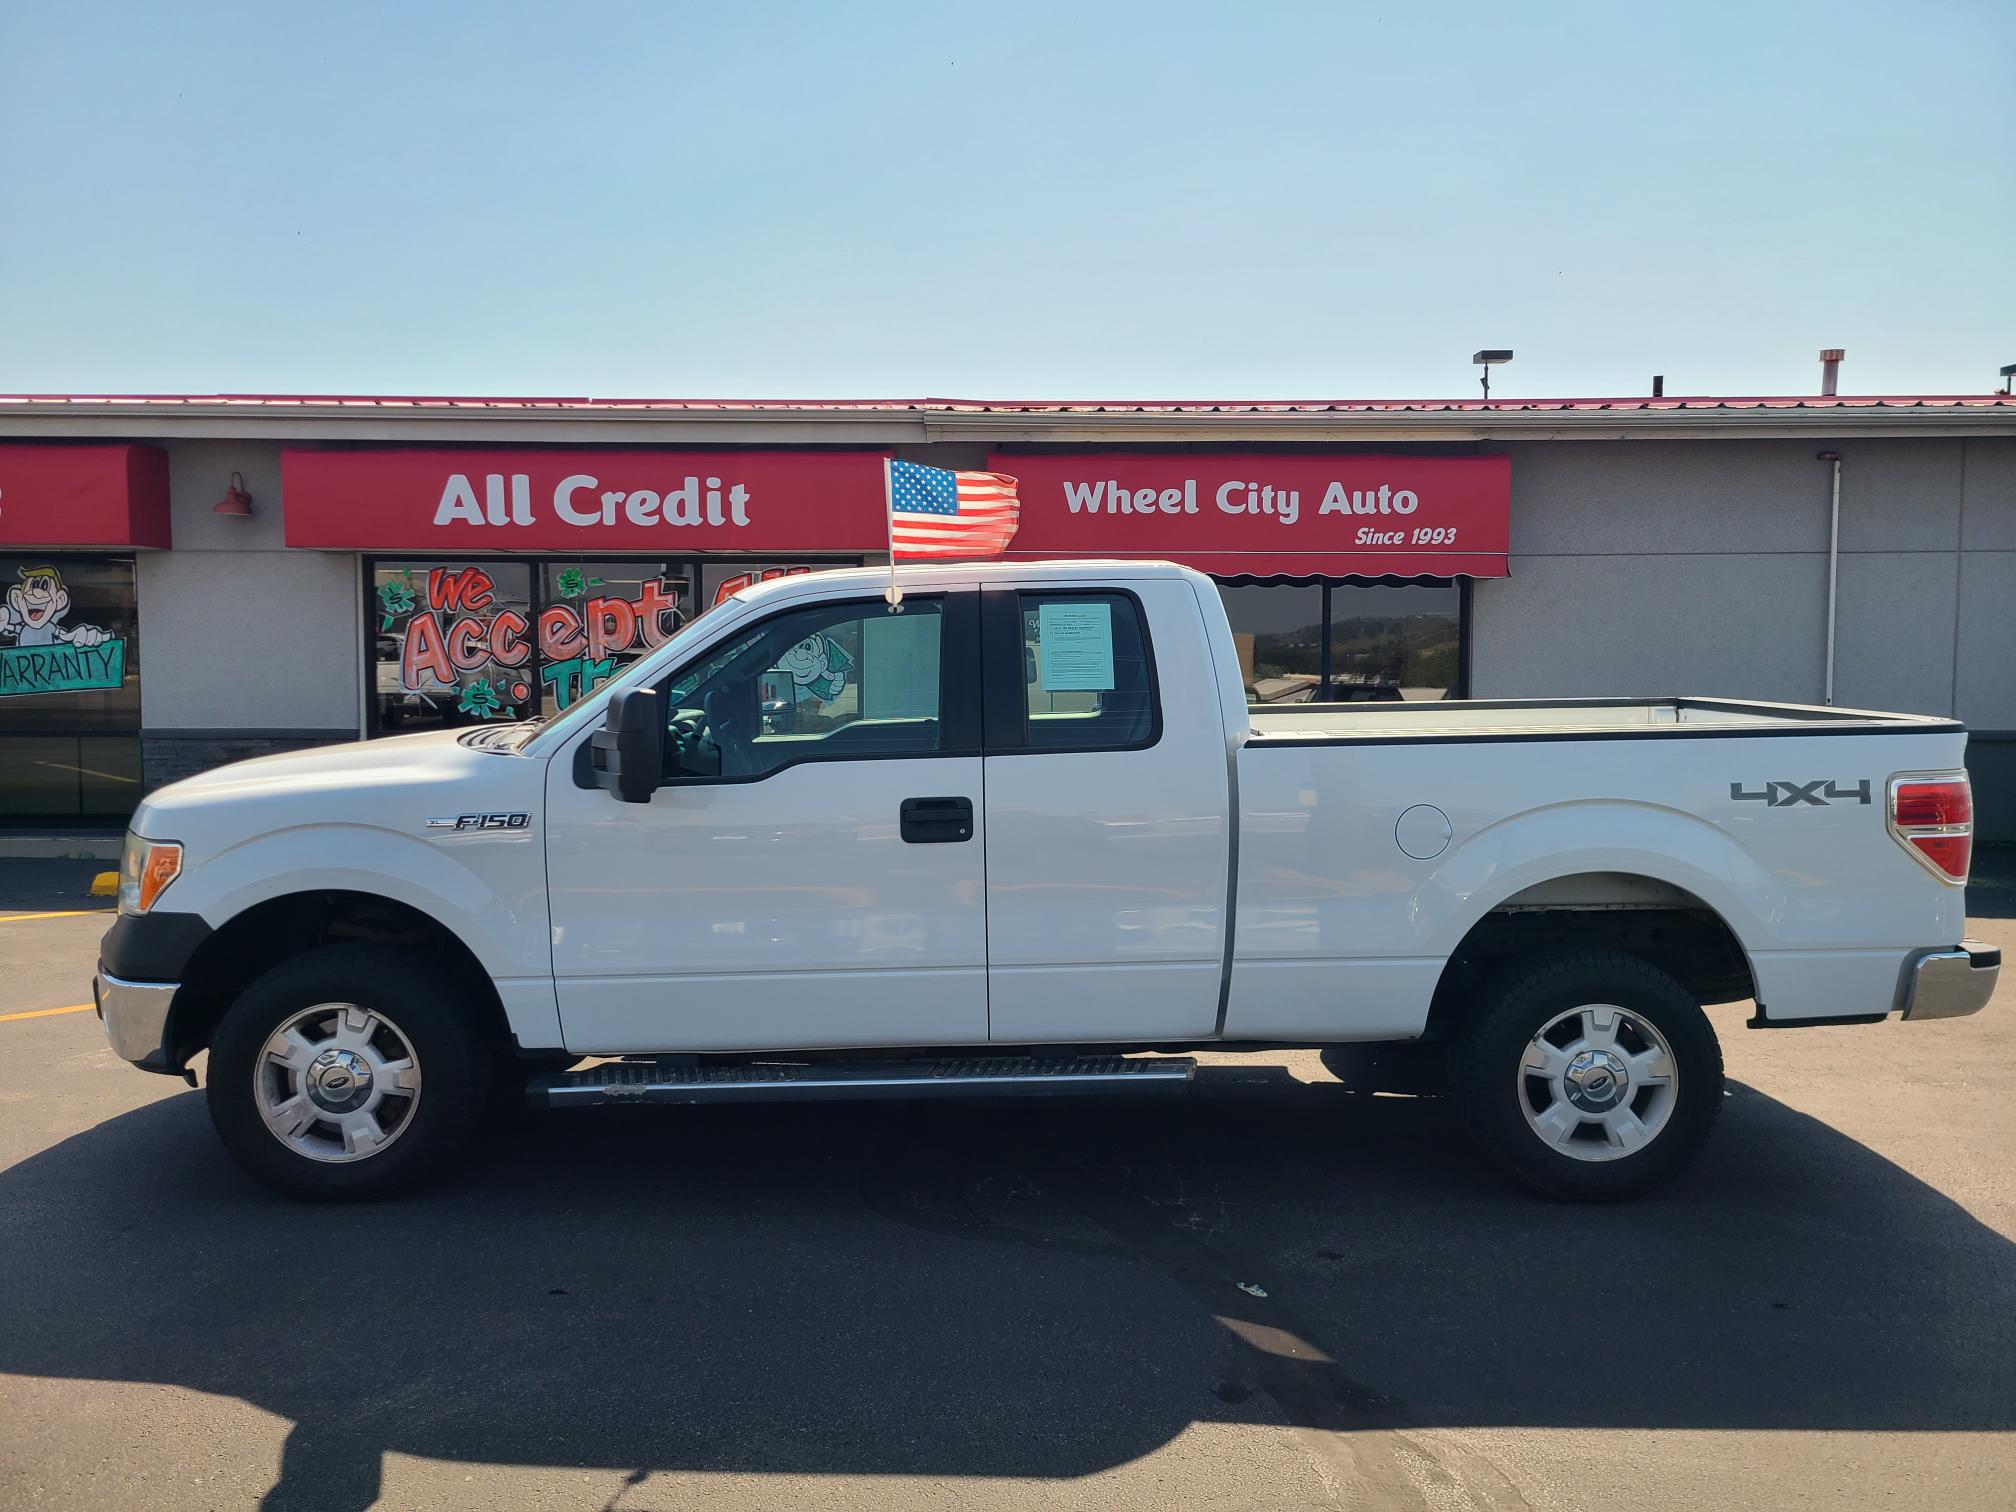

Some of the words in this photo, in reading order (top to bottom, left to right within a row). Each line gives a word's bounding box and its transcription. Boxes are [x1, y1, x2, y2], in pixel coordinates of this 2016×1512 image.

[433, 474, 536, 526] All
[553, 474, 750, 526] Credit
[1063, 480, 1199, 514] Wheel
[1215, 481, 1299, 524] City
[1318, 481, 1418, 515] Auto
[1354, 527, 1405, 545] Since
[1411, 527, 1457, 545] 1993
[0, 646, 114, 688] ARRANTY
